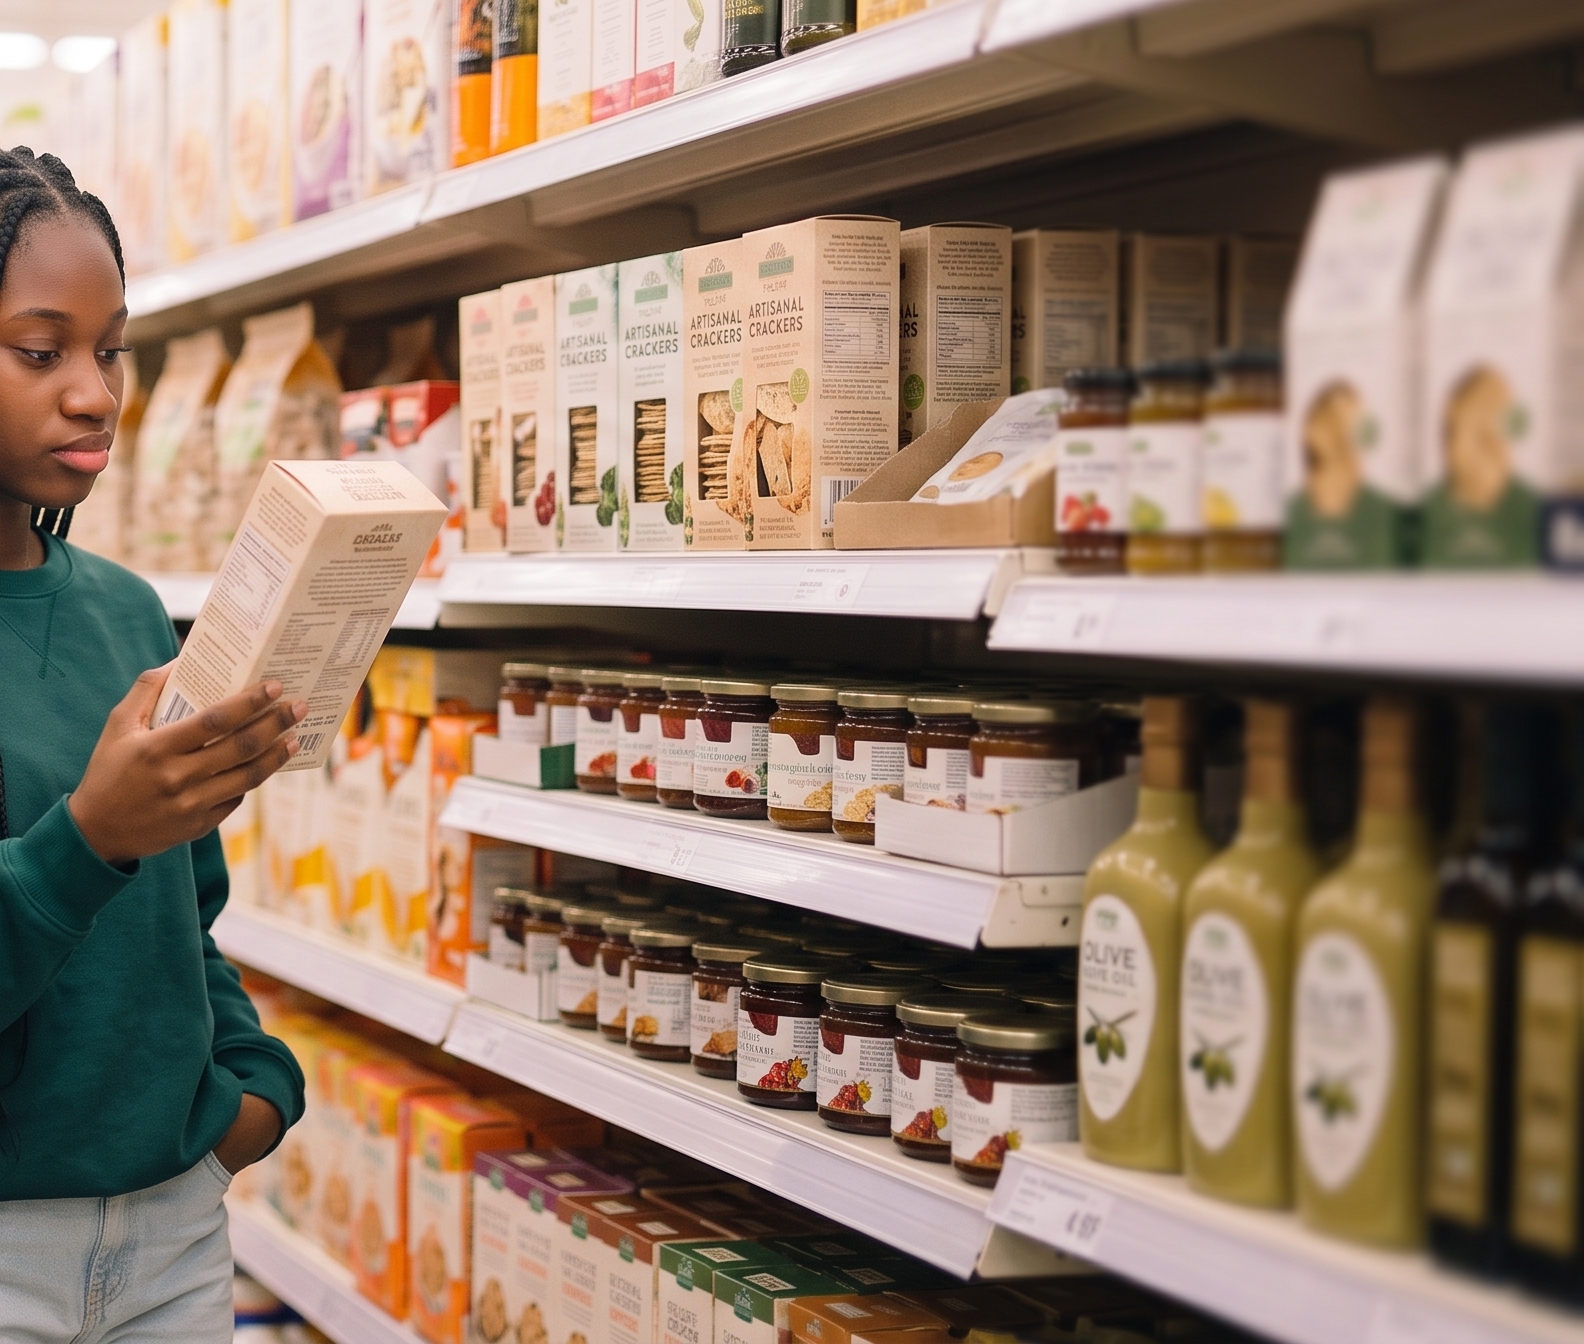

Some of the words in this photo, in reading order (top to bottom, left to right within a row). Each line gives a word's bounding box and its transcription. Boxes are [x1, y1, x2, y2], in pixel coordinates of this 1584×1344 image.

[748, 296, 805, 320] ARTISANAL
[690, 309, 743, 331] ARTISANAL
[748, 315, 804, 339] CRACKERS
[624, 321, 679, 342] ARTISANAL
[690, 327, 743, 349] CRACKERS
[624, 338, 679, 360] CRACKERS
[1083, 940, 1137, 971] OLIVE
